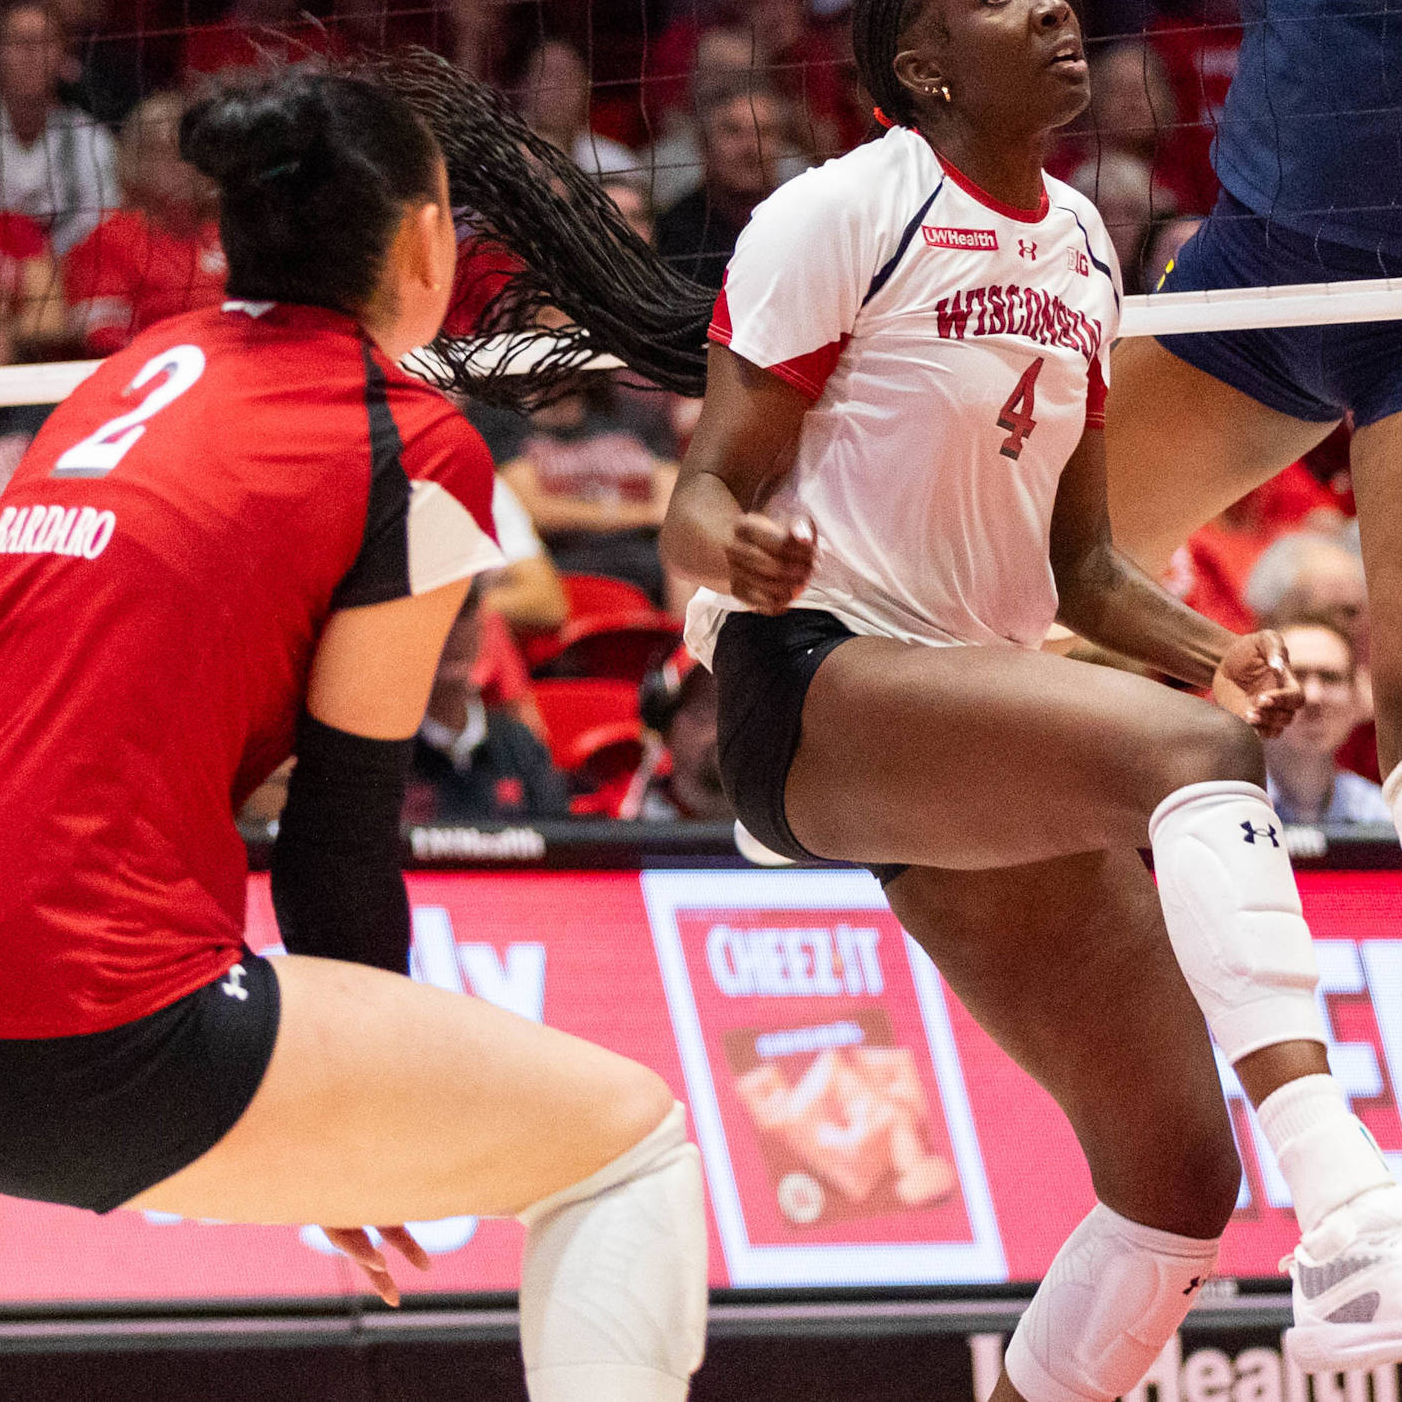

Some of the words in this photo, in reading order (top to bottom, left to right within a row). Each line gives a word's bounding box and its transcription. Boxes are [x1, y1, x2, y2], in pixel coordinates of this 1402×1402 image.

[924, 228, 995, 248] UWHealth
[934, 284, 1102, 366] WISCONSIN
[50, 343, 207, 479] 2
[996, 356, 1045, 461] 4
